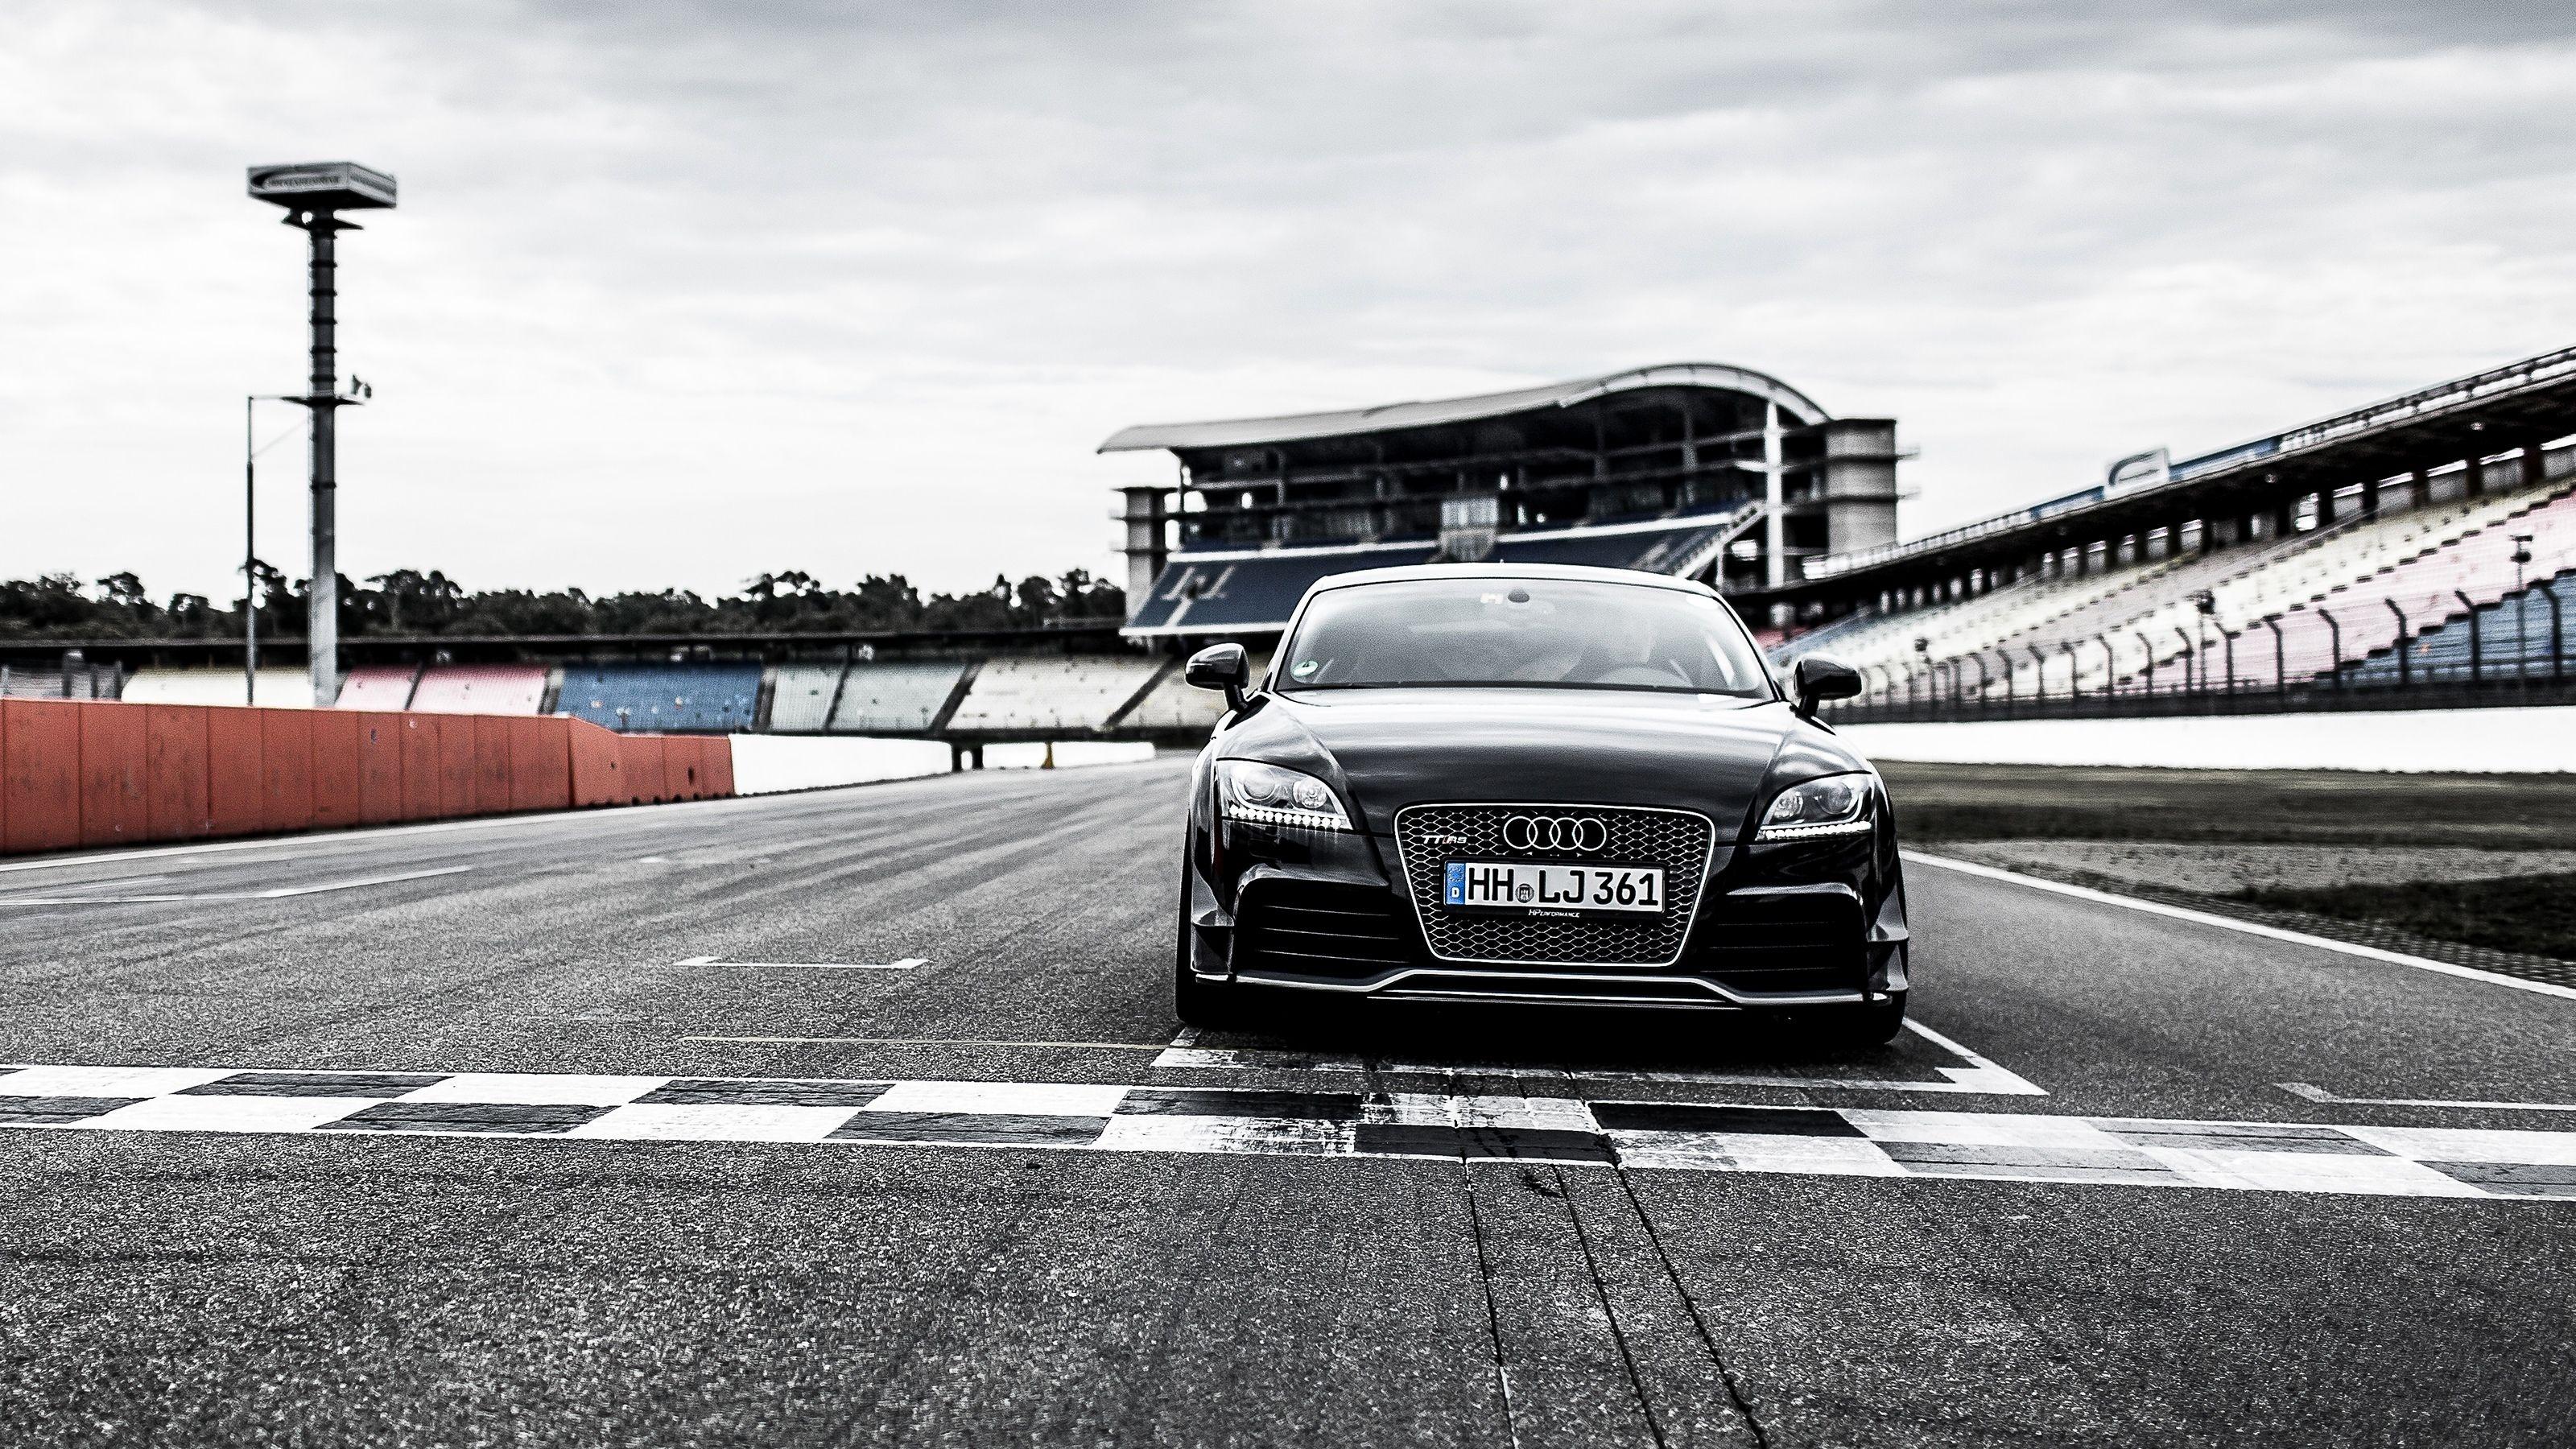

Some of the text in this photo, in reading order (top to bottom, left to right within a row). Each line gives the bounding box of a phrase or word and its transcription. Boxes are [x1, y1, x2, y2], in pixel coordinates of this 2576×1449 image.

[1468, 868, 1658, 906] HH LJ 361
